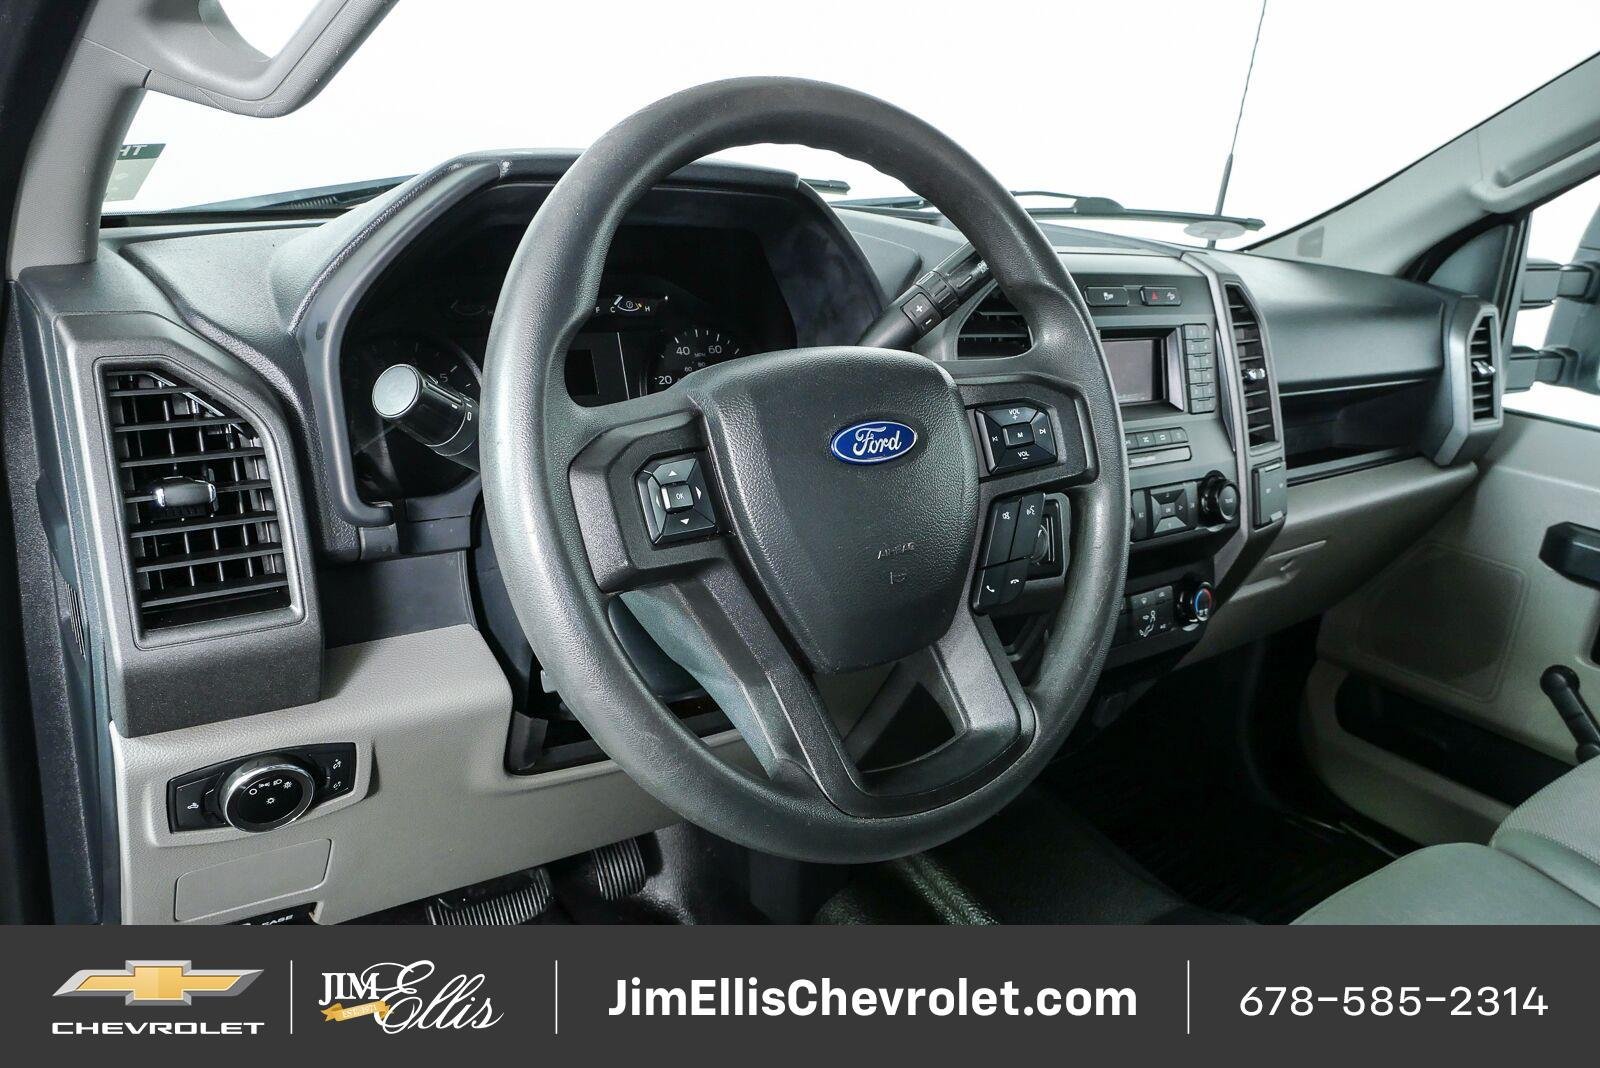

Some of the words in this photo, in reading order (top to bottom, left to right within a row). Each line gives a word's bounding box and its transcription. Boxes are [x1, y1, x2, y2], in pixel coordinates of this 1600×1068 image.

[676, 346, 690, 355] 40
[708, 345, 722, 354] 60
[658, 375, 673, 385] 20
[853, 426, 902, 456] Ford
[1017, 450, 1030, 458] VOL
[675, 492, 685, 500] OK
